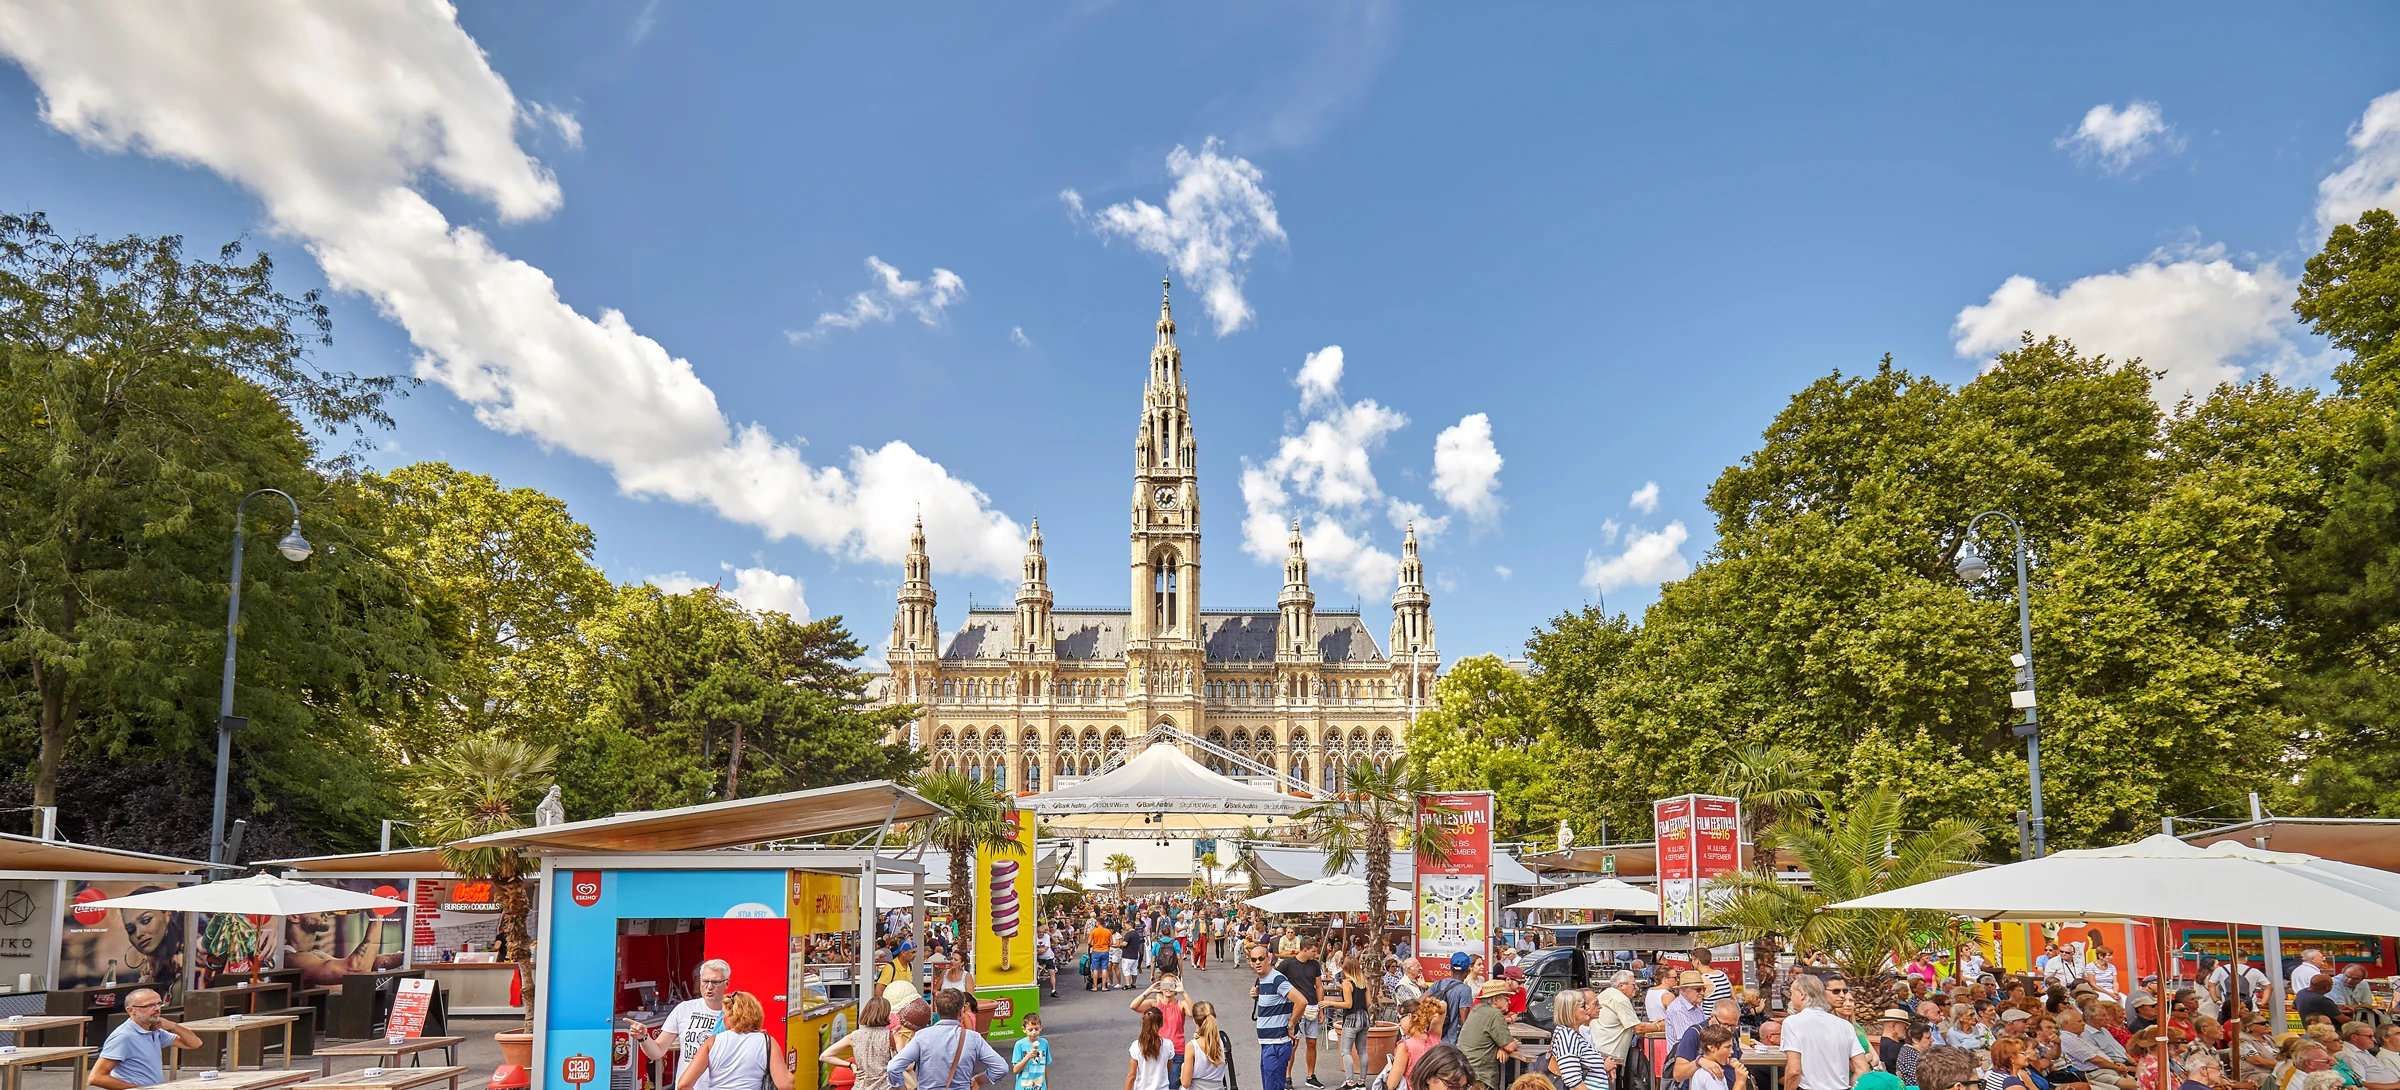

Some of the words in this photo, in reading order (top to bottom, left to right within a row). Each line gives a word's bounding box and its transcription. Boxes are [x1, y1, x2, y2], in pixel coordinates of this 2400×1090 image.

[1659, 820, 1670, 834] FILM
[1670, 815, 1690, 831] FESTIVAL
[1697, 817, 1710, 830] FILM
[1710, 817, 1736, 831] FESTIVAL
[1670, 828, 1687, 840] 2016
[1711, 828, 1730, 840] 2016
[1667, 853, 1688, 861] SEPTEMBER
[1707, 853, 1732, 861] SEPTEMBER
[1542, 981, 1562, 993] ICED
